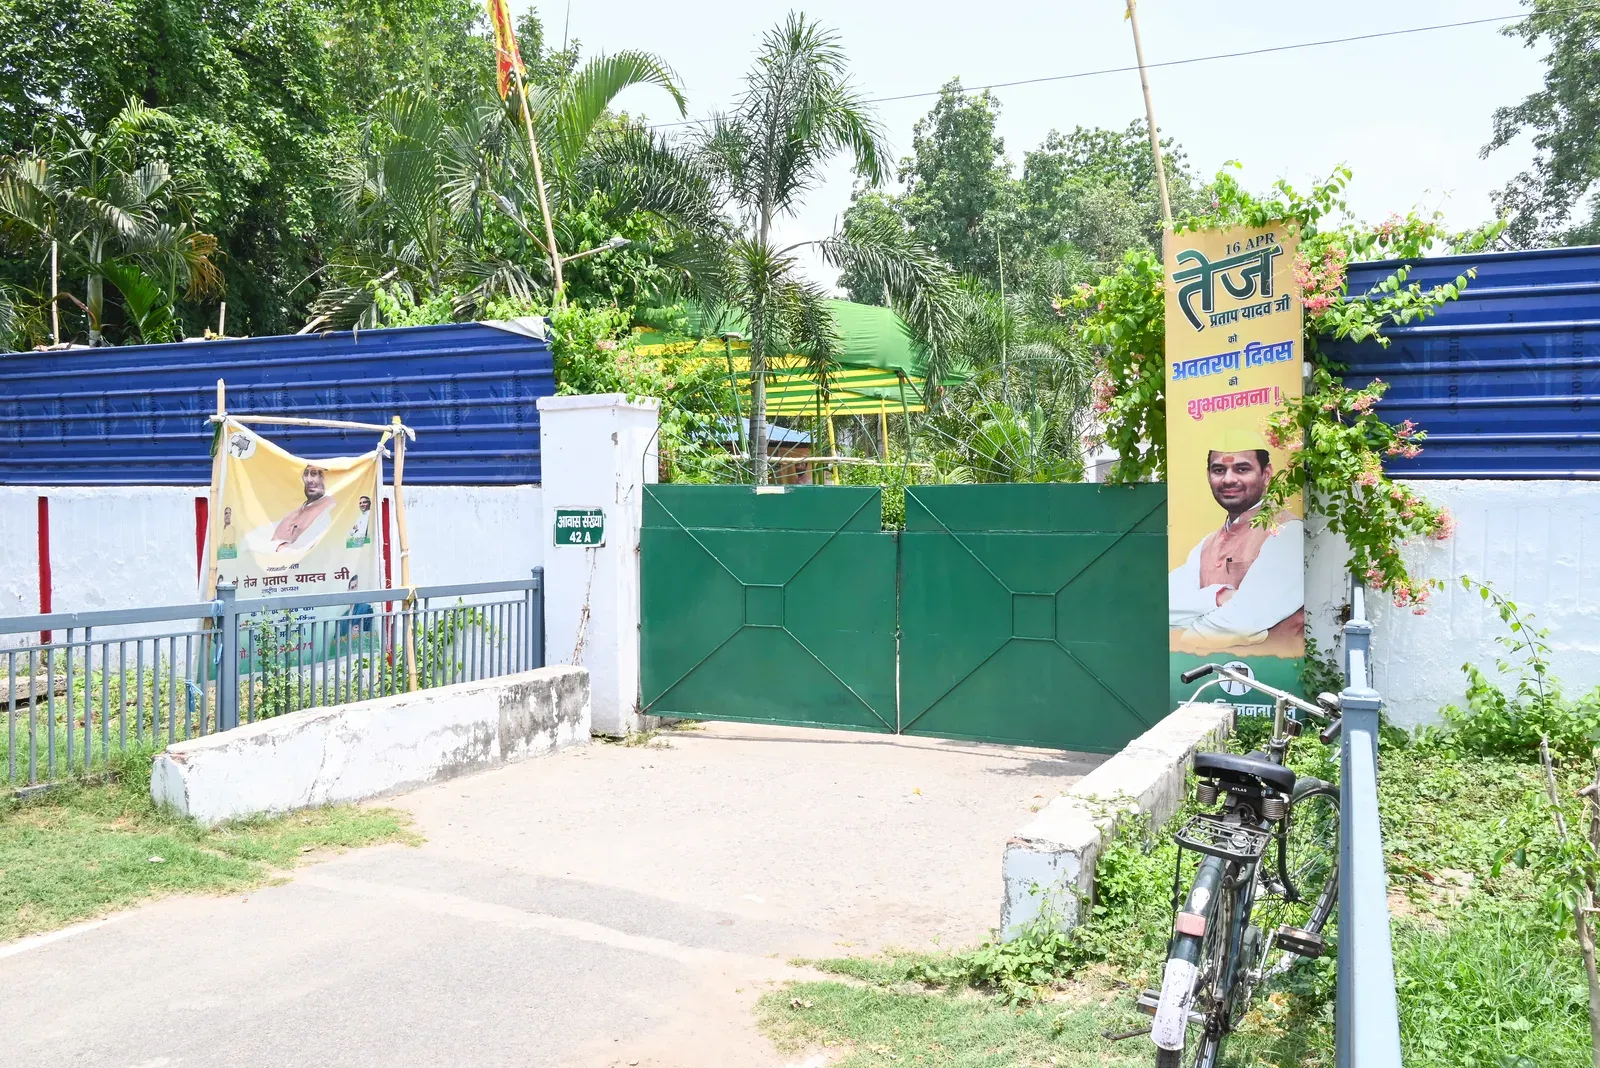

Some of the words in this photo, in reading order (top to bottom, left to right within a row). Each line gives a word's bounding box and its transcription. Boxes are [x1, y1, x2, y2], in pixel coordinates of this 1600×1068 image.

[1225, 241, 1241, 256] 16
[1245, 232, 1275, 250] APR
[1171, 244, 1283, 332] तेज
[1208, 308, 1239, 328] प्रताप
[1241, 301, 1272, 320] यादव
[1275, 294, 1291, 312] जी
[1227, 333, 1238, 344] को
[1171, 350, 1241, 381] अवतरण
[1244, 340, 1294, 368] दिवस
[1228, 376, 1238, 386] की
[1187, 387, 1270, 421] शुभकामना
[557, 515, 581, 528] आवास
[582, 511, 602, 528] संख्या
[569, 531, 582, 543] 42
[584, 531, 591, 543] A
[243, 575, 257, 588] तेज
[262, 574, 288, 587] प्रताप
[295, 572, 326, 583] यादव
[334, 566, 350, 580] जी
